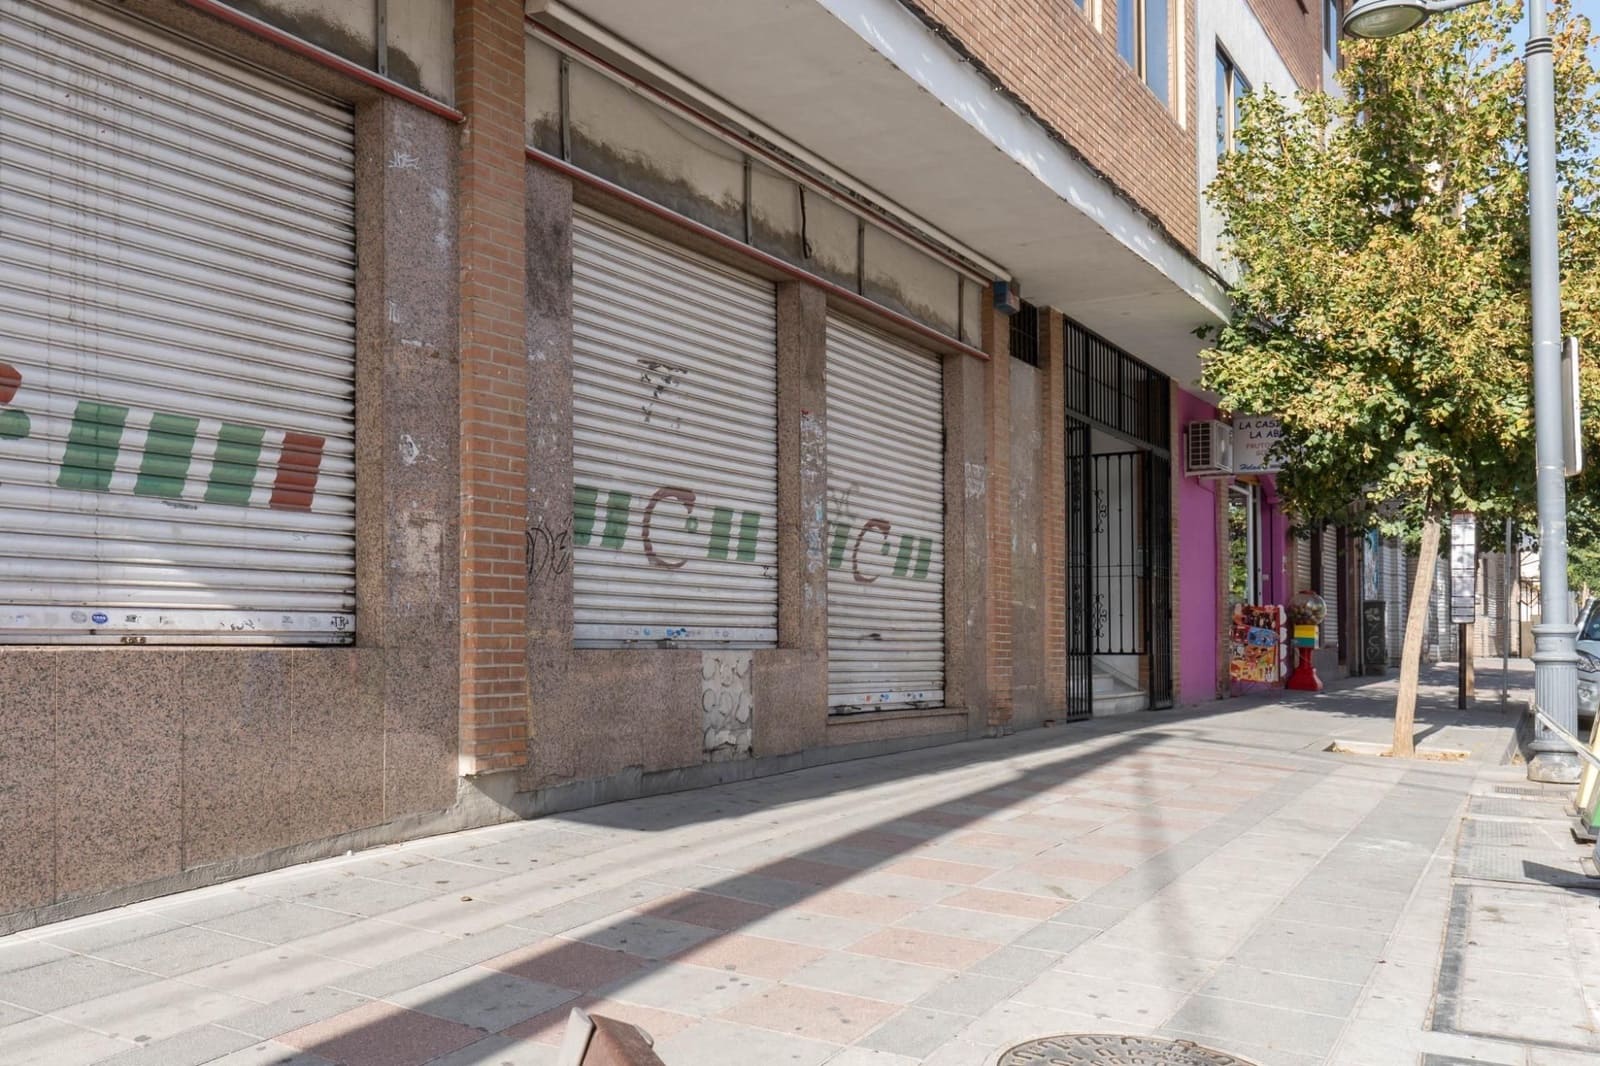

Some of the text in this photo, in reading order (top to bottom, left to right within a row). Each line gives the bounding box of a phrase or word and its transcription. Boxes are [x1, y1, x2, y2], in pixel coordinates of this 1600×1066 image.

[1239, 420, 1281, 430] LA CASI
[1249, 431, 1262, 439] LA
